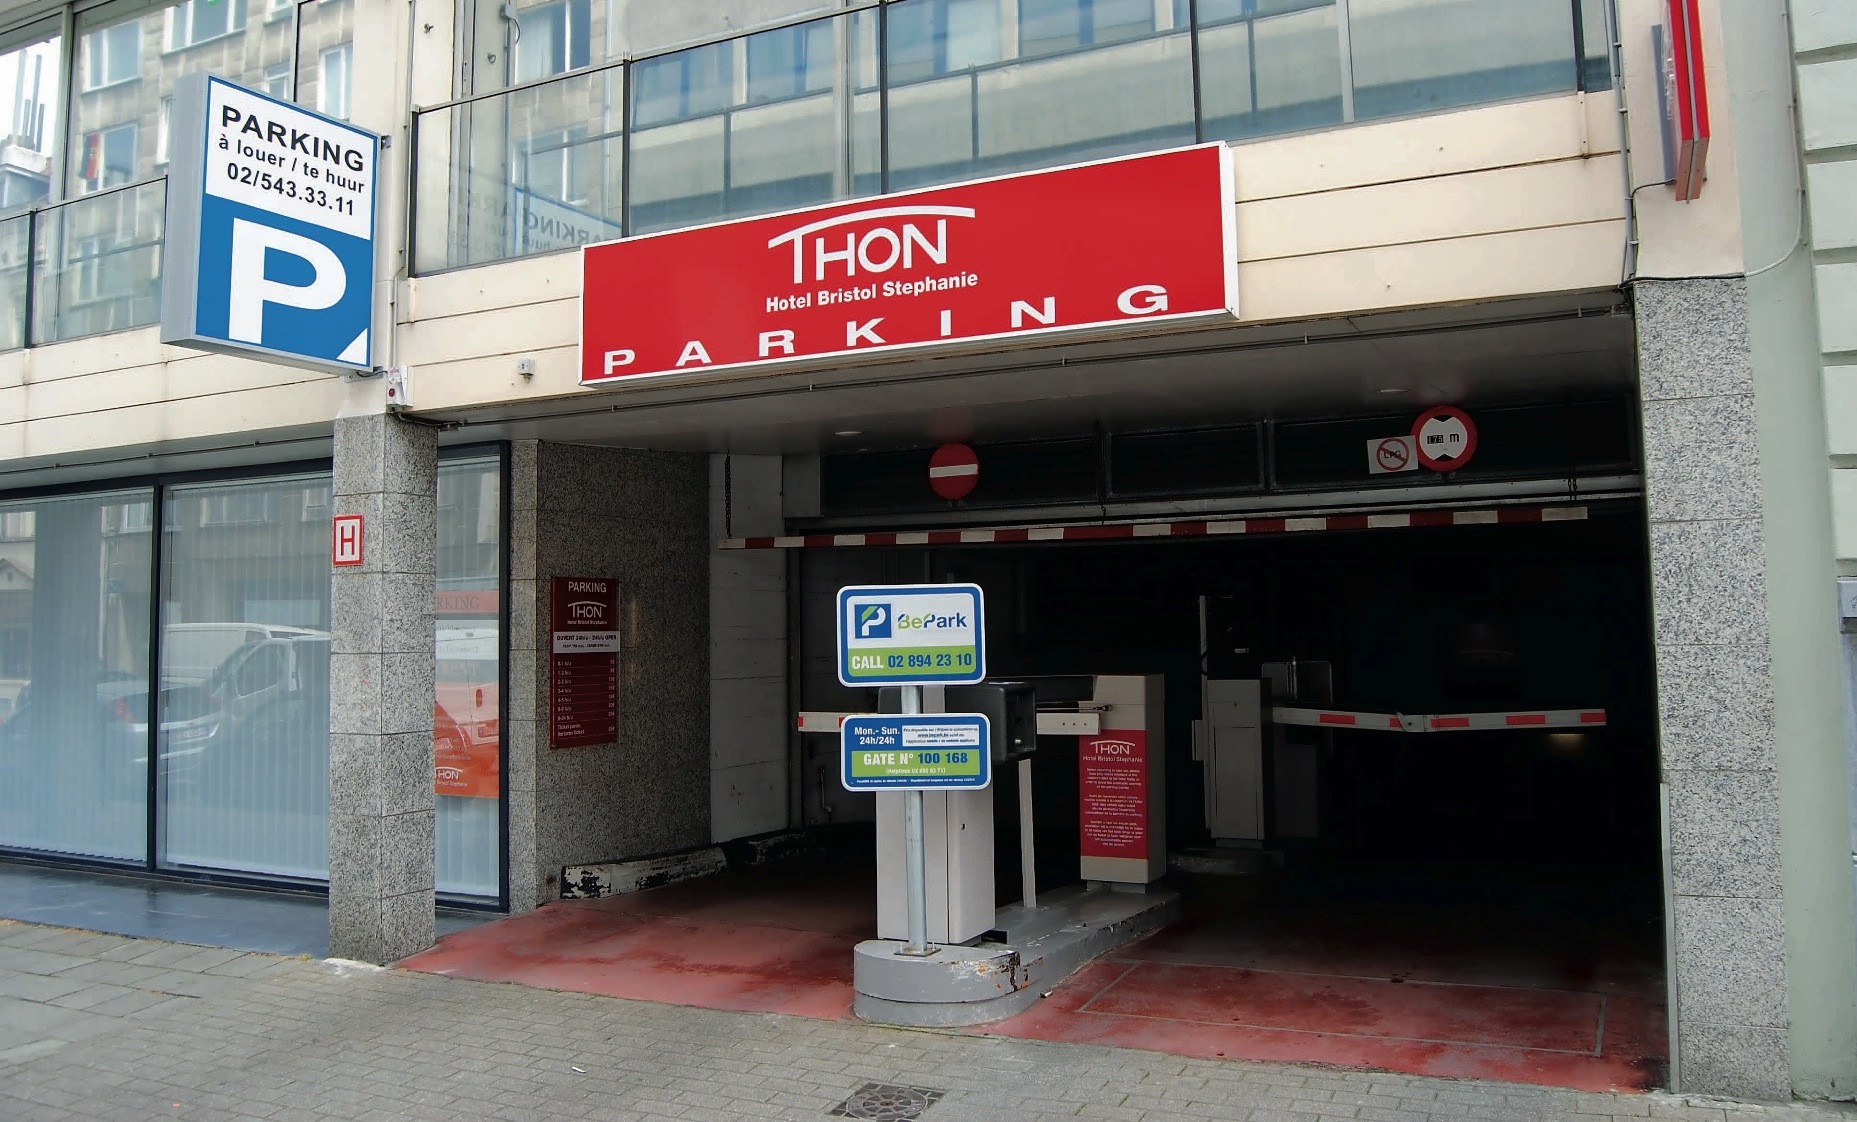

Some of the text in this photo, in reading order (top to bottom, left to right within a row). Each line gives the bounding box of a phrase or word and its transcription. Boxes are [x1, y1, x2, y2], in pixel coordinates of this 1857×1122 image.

[222, 104, 363, 171] PARKING
[218, 133, 365, 193] à louer / te huur
[227, 162, 353, 216] 02/543.33.11
[768, 205, 975, 284] THON
[228, 217, 347, 345] P
[765, 271, 978, 313] Hotel Bristol Stephanie
[603, 285, 1169, 375] PARKING
[1450, 433, 1459, 443] m
[341, 525, 355, 556] H
[568, 581, 607, 593] PARKING
[568, 601, 607, 618] THON
[898, 613, 967, 629] BePark
[852, 653, 972, 669] CALL 02 894 23 10
[882, 727, 900, 735] Sun.
[860, 736, 895, 745] 24h/24h
[1090, 740, 1135, 754] THON
[863, 752, 968, 766] GATE N° 100 168
